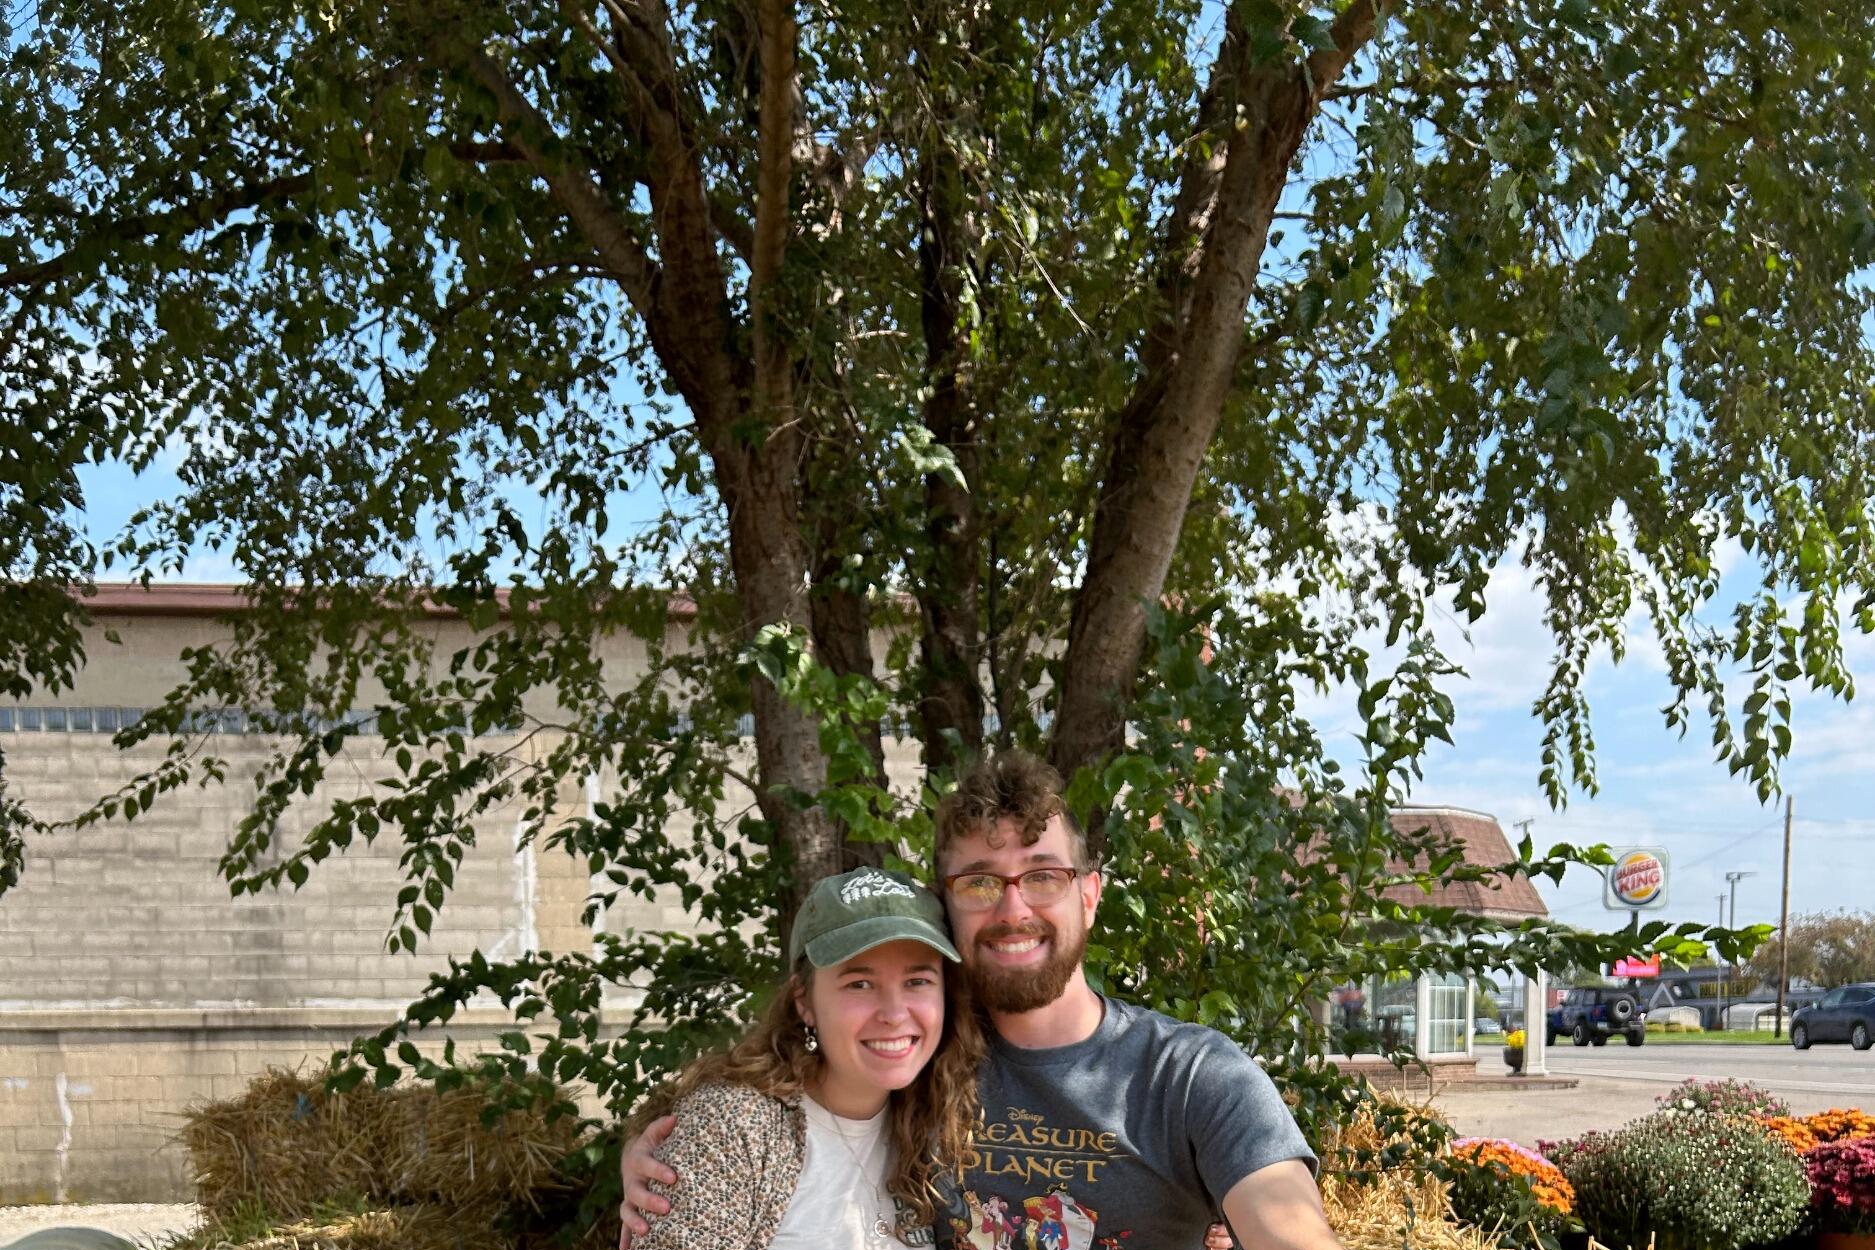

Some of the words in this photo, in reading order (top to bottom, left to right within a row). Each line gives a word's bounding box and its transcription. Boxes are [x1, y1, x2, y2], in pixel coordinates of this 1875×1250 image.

[1616, 860, 1657, 880] BURGER
[1619, 870, 1660, 894] KING
[973, 1123, 1117, 1152] REASURE
[958, 1150, 1106, 1185] PLANET
